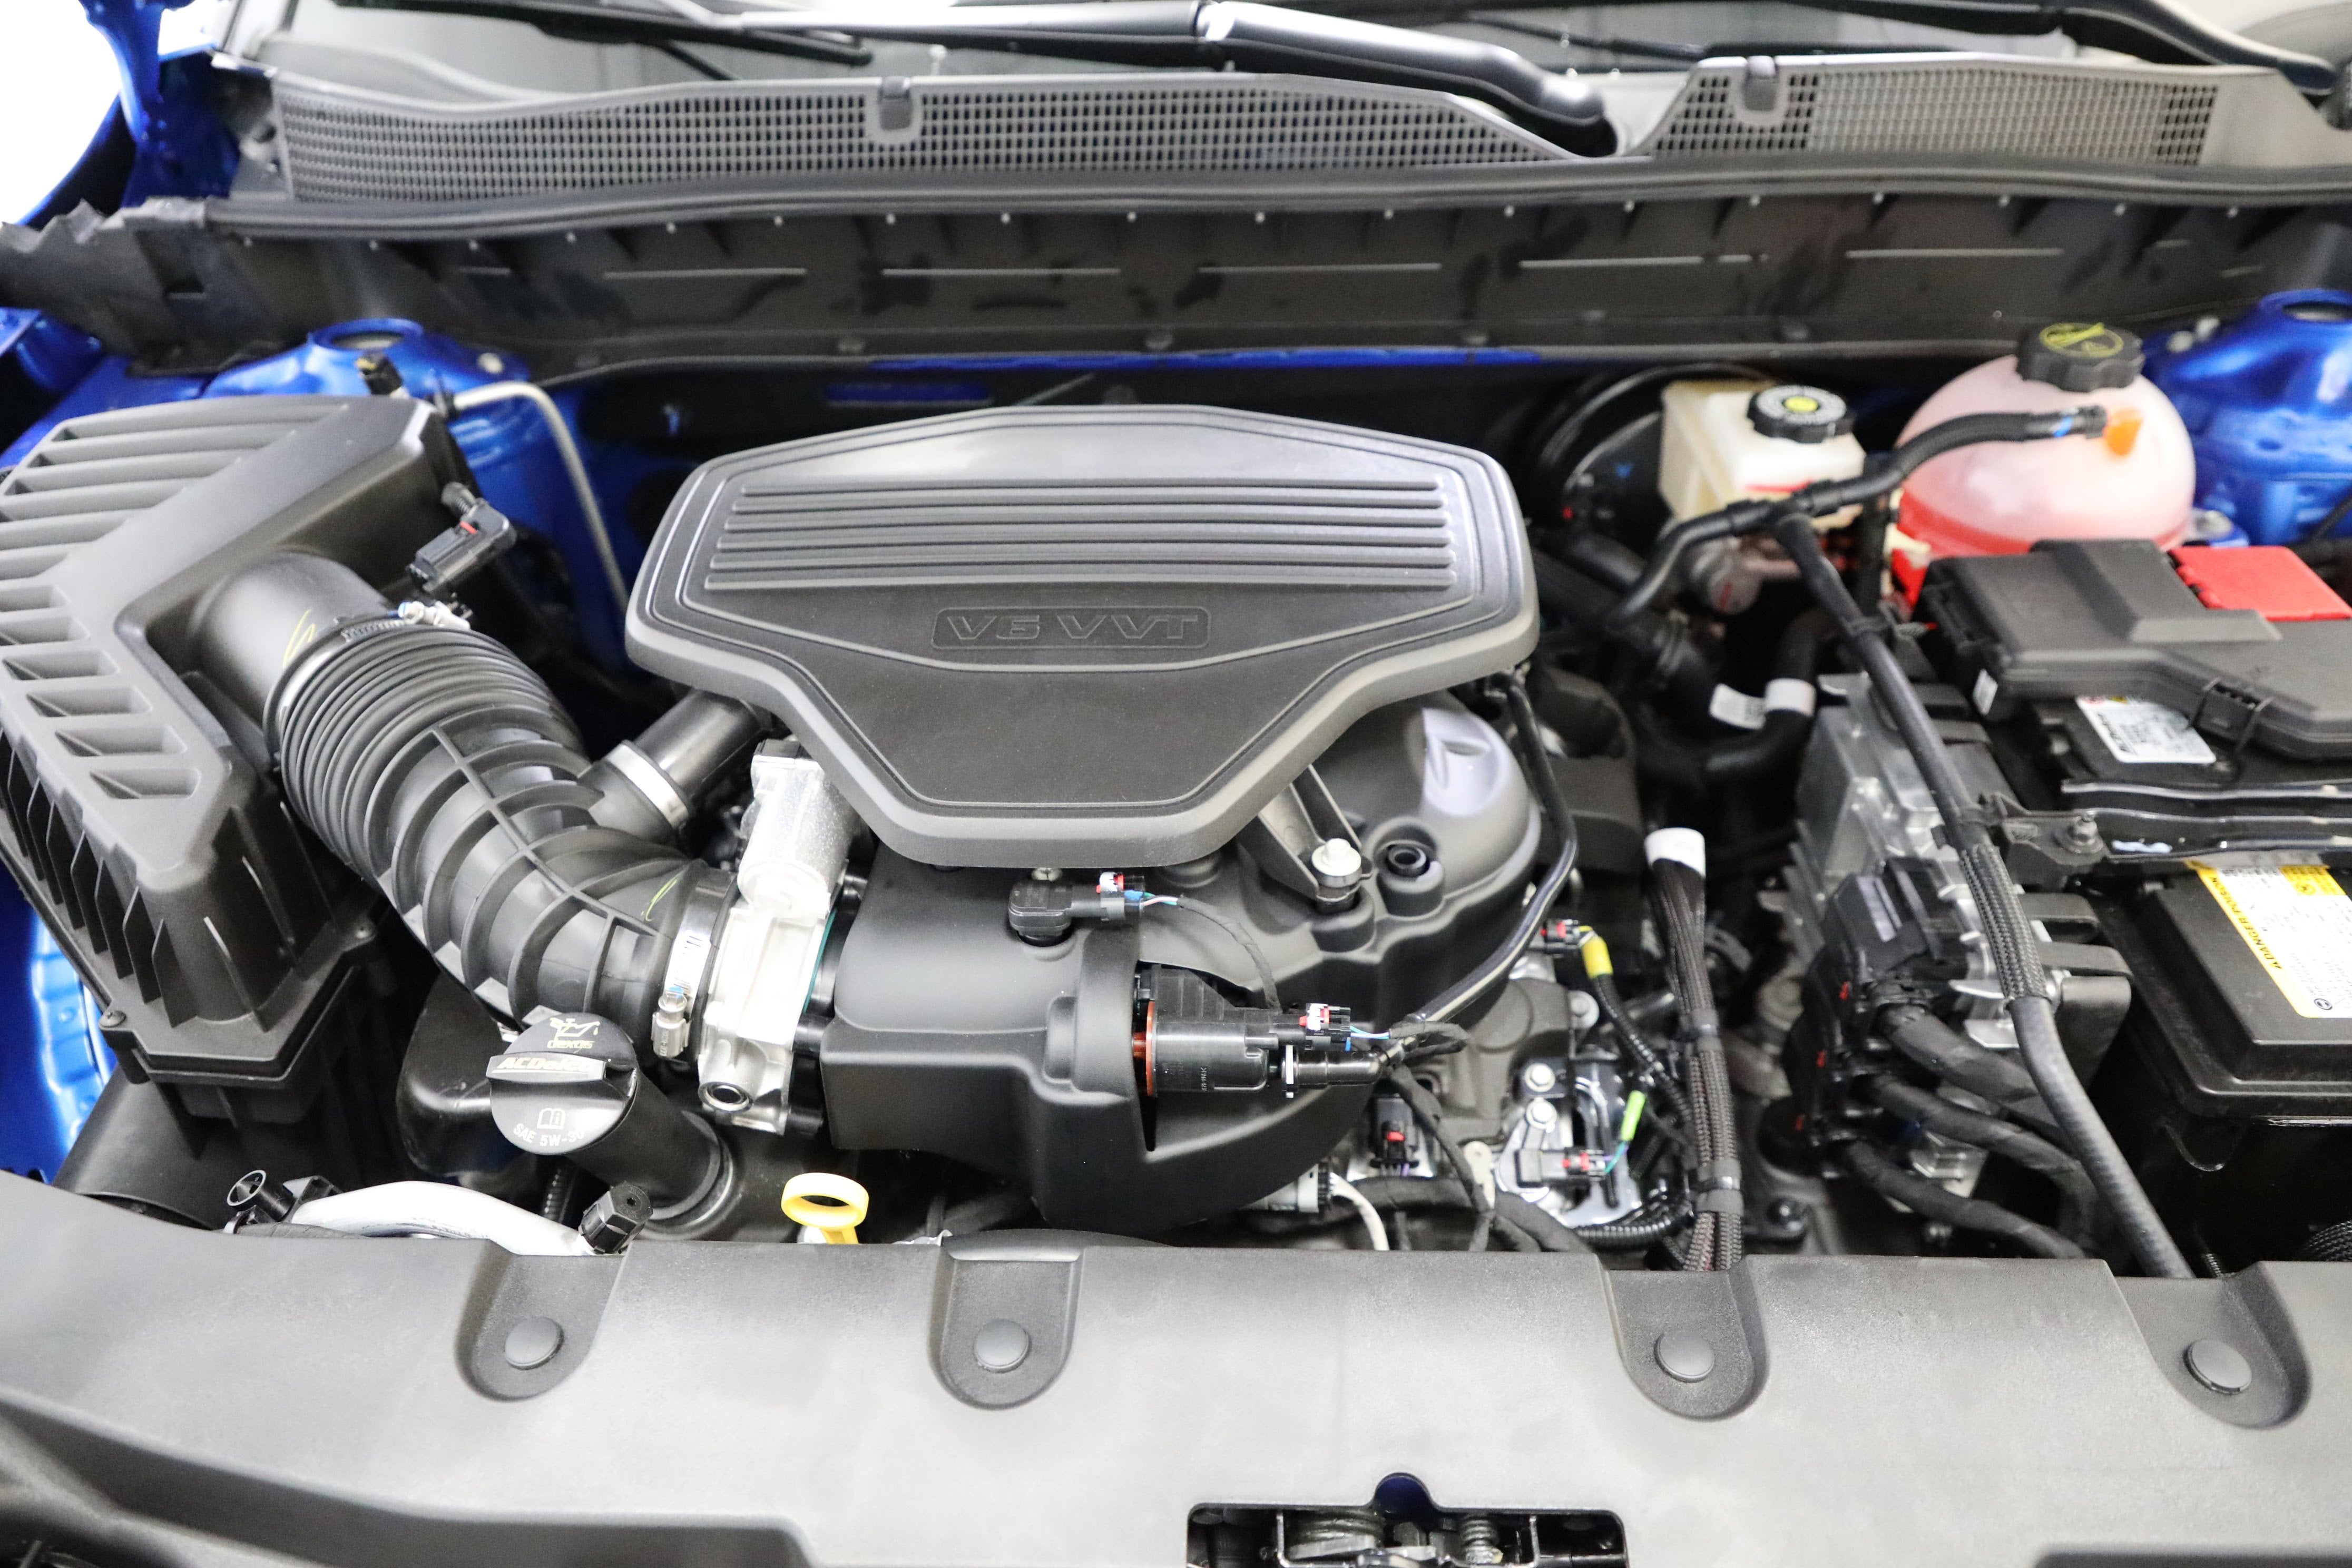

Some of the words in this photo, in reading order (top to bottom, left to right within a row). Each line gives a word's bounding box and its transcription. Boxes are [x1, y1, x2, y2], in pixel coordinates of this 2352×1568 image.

[946, 614, 1040, 641] V6
[1056, 614, 1199, 641] VVT
[2238, 916, 2277, 959] DANGER
[496, 1056, 591, 1072] ACDelco
[513, 1123, 536, 1143] SAE
[539, 1128, 584, 1146] 5W-30
